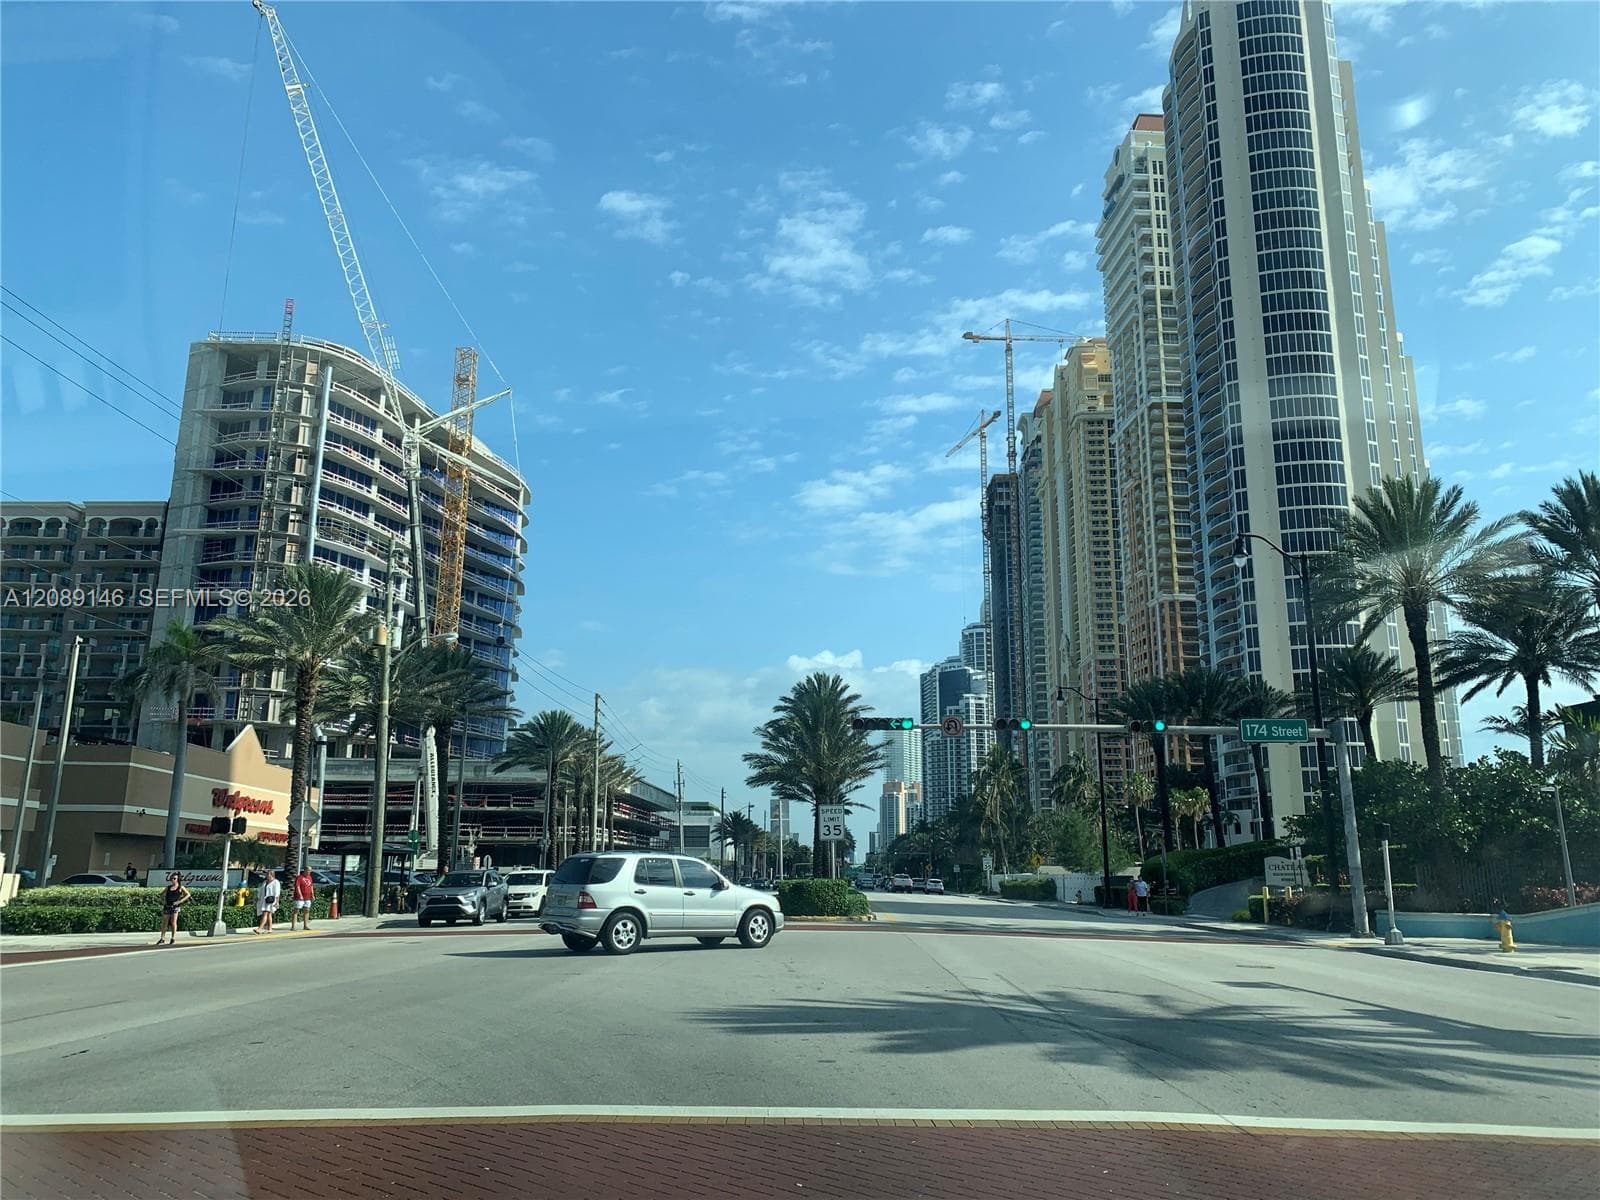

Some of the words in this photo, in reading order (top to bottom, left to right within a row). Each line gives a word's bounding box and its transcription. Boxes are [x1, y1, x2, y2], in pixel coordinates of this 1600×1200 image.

[1246, 724, 1268, 737] 174
[1271, 726, 1303, 737] Street
[212, 788, 274, 816] Walgreens
[823, 825, 842, 836] 35
